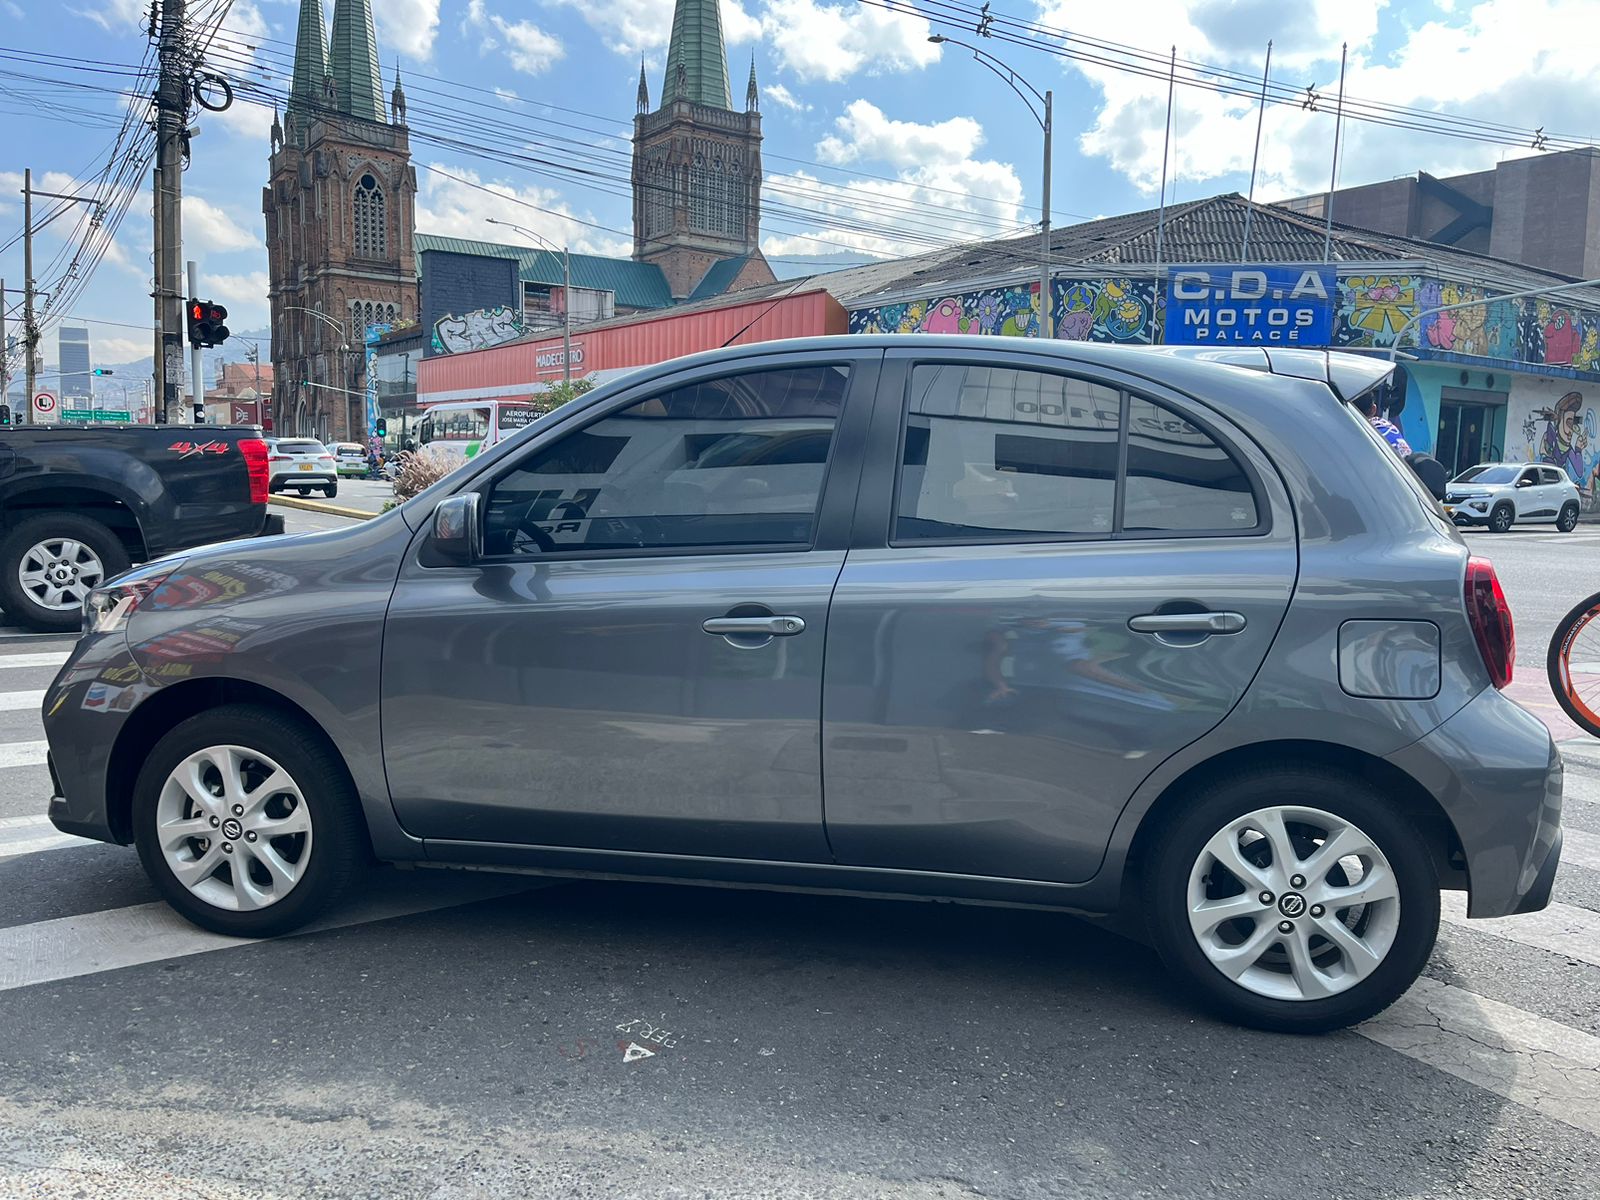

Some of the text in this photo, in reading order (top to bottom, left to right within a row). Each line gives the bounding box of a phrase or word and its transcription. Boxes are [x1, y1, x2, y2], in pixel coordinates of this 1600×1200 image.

[1174, 271, 1328, 299] C.D.A
[1184, 308, 1314, 326] MOTOS
[1196, 326, 1298, 339] PALACÉ
[536, 349, 583, 368] MADECETRO
